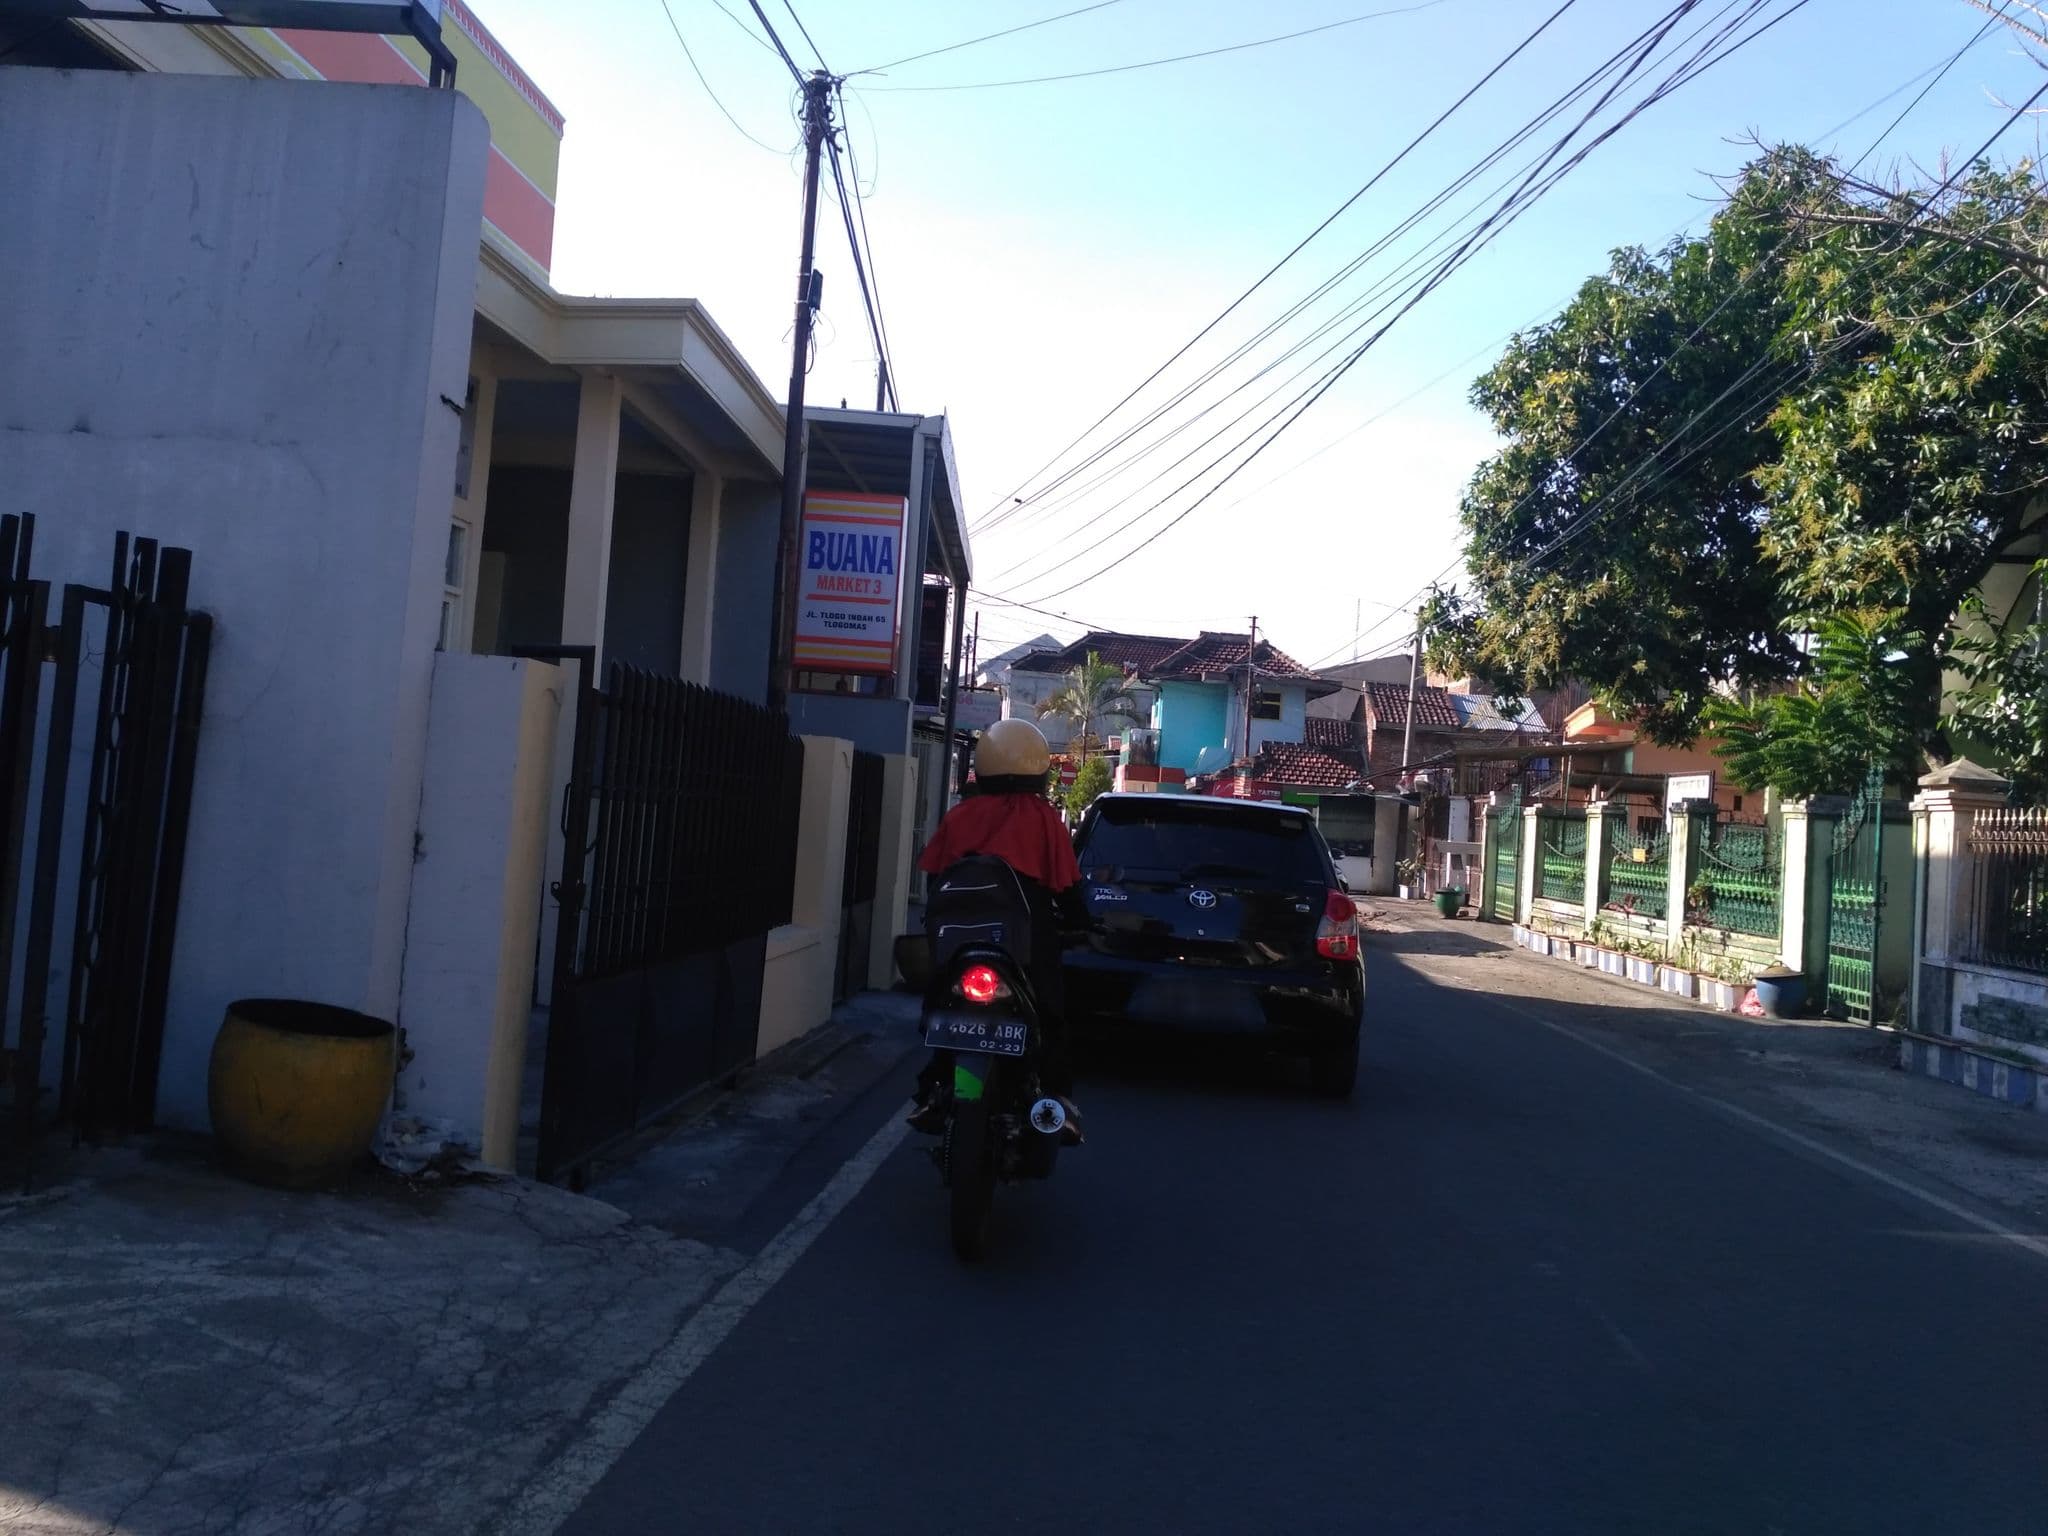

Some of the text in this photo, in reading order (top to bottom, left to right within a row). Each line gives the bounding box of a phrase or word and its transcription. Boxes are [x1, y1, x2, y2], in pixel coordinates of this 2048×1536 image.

[808, 531, 894, 575] BUANA
[816, 575, 882, 594] MARKET 3
[820, 612, 845, 620] TLOGO
[848, 614, 873, 622] INDAH
[824, 621, 867, 630] TLOGOMAS
[994, 1024, 1024, 1040] ABK
